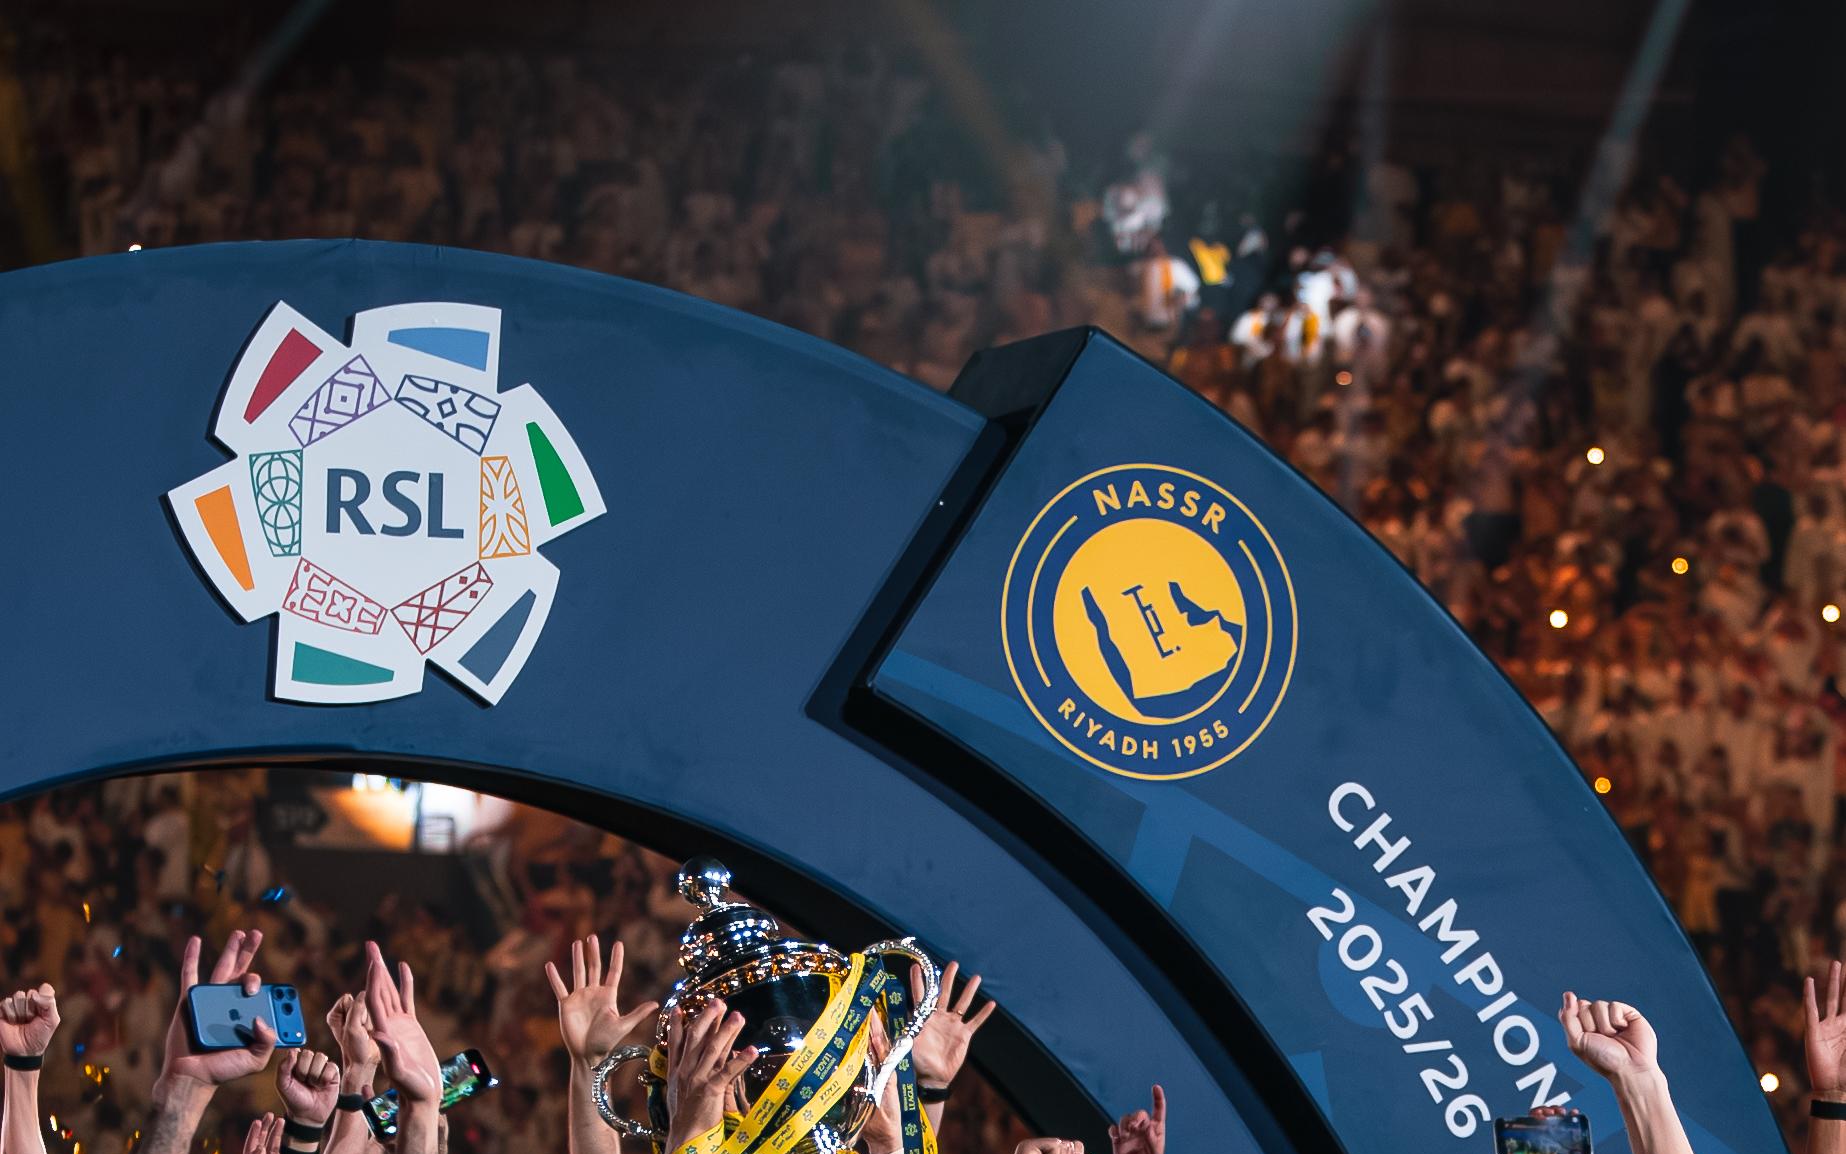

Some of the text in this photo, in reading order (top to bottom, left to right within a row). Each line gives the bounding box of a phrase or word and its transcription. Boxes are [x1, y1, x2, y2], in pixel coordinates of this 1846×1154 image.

[325, 468, 465, 539] RSL
[1093, 480, 1227, 534] NASSR
[1057, 697, 1230, 760] RIYADH 1955
[1327, 781, 1573, 1110] CHAMPION
[1305, 887, 1492, 1139] 2025/26
